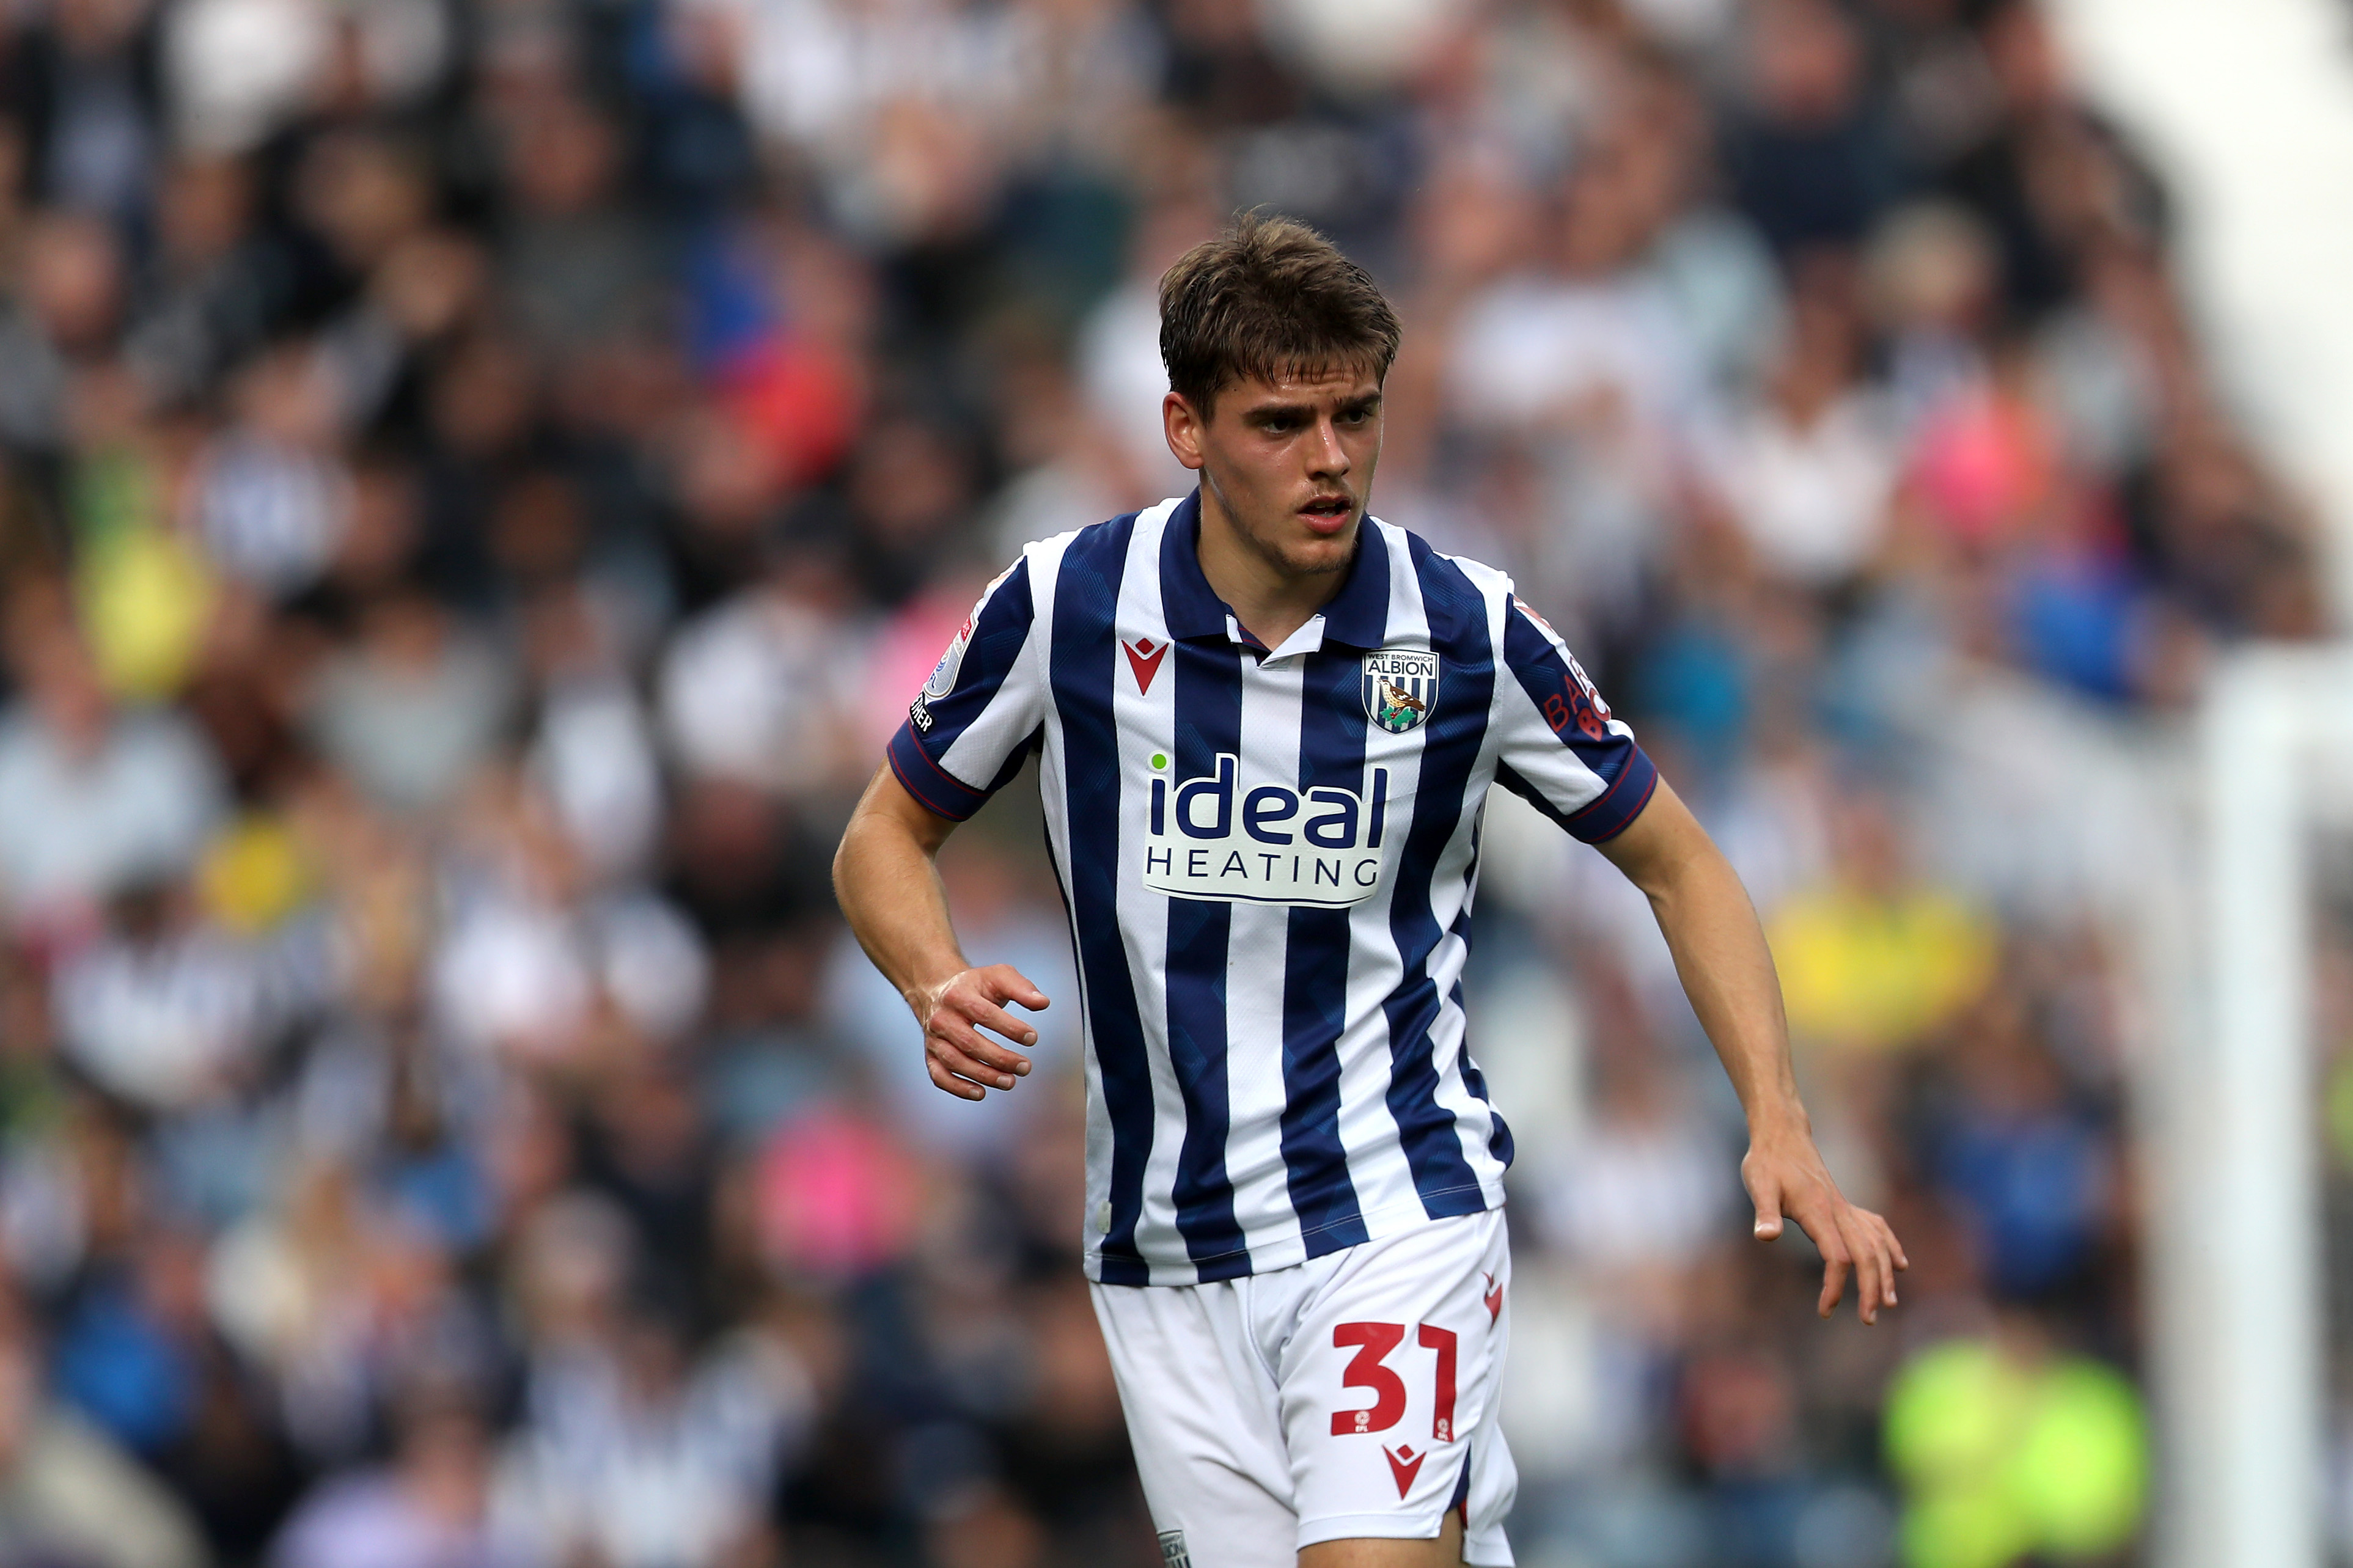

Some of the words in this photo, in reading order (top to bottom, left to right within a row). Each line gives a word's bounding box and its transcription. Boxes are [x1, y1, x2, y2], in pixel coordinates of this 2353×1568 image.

[1368, 660, 1433, 676] ALBION
[1151, 753, 1388, 849] ideal
[1147, 846, 1378, 887] HEATING
[1331, 1322, 1458, 1443] 31
